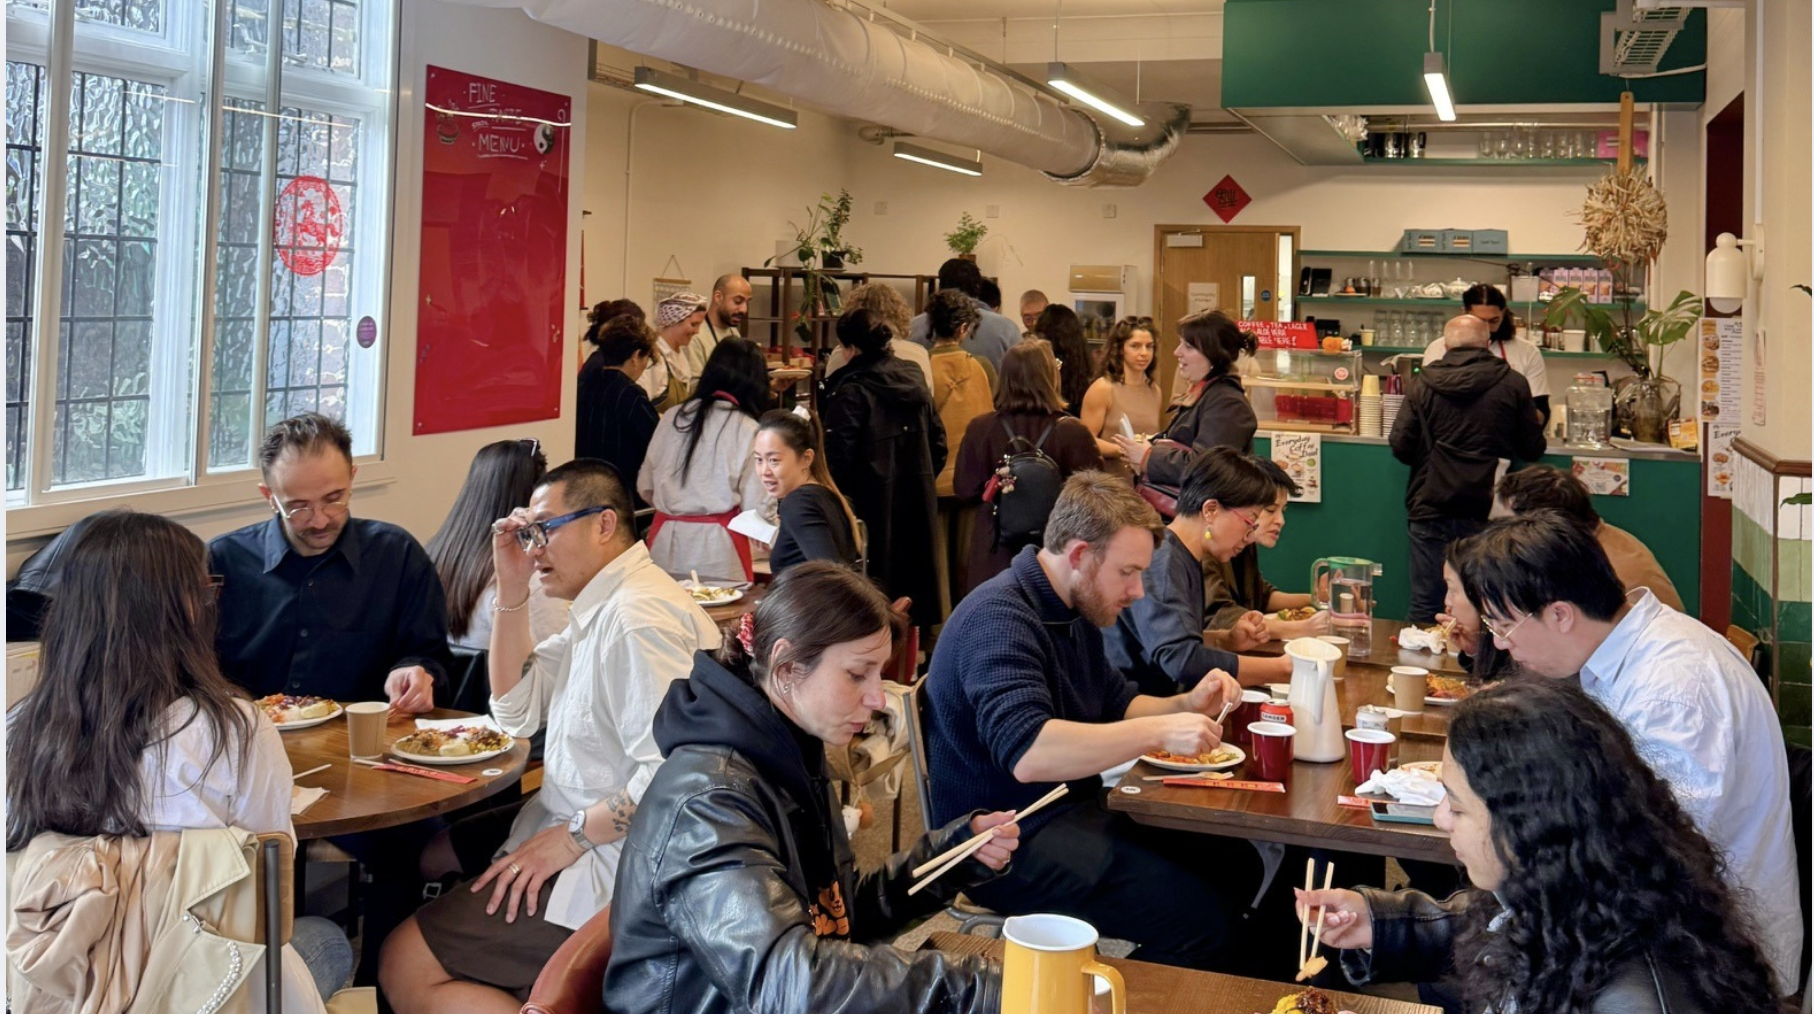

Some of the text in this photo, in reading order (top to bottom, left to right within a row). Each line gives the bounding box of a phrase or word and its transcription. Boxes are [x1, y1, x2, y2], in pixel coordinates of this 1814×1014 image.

[469, 82, 497, 103] FINE
[478, 133, 520, 153] MENU
[1275, 435, 1310, 447] Everyday
